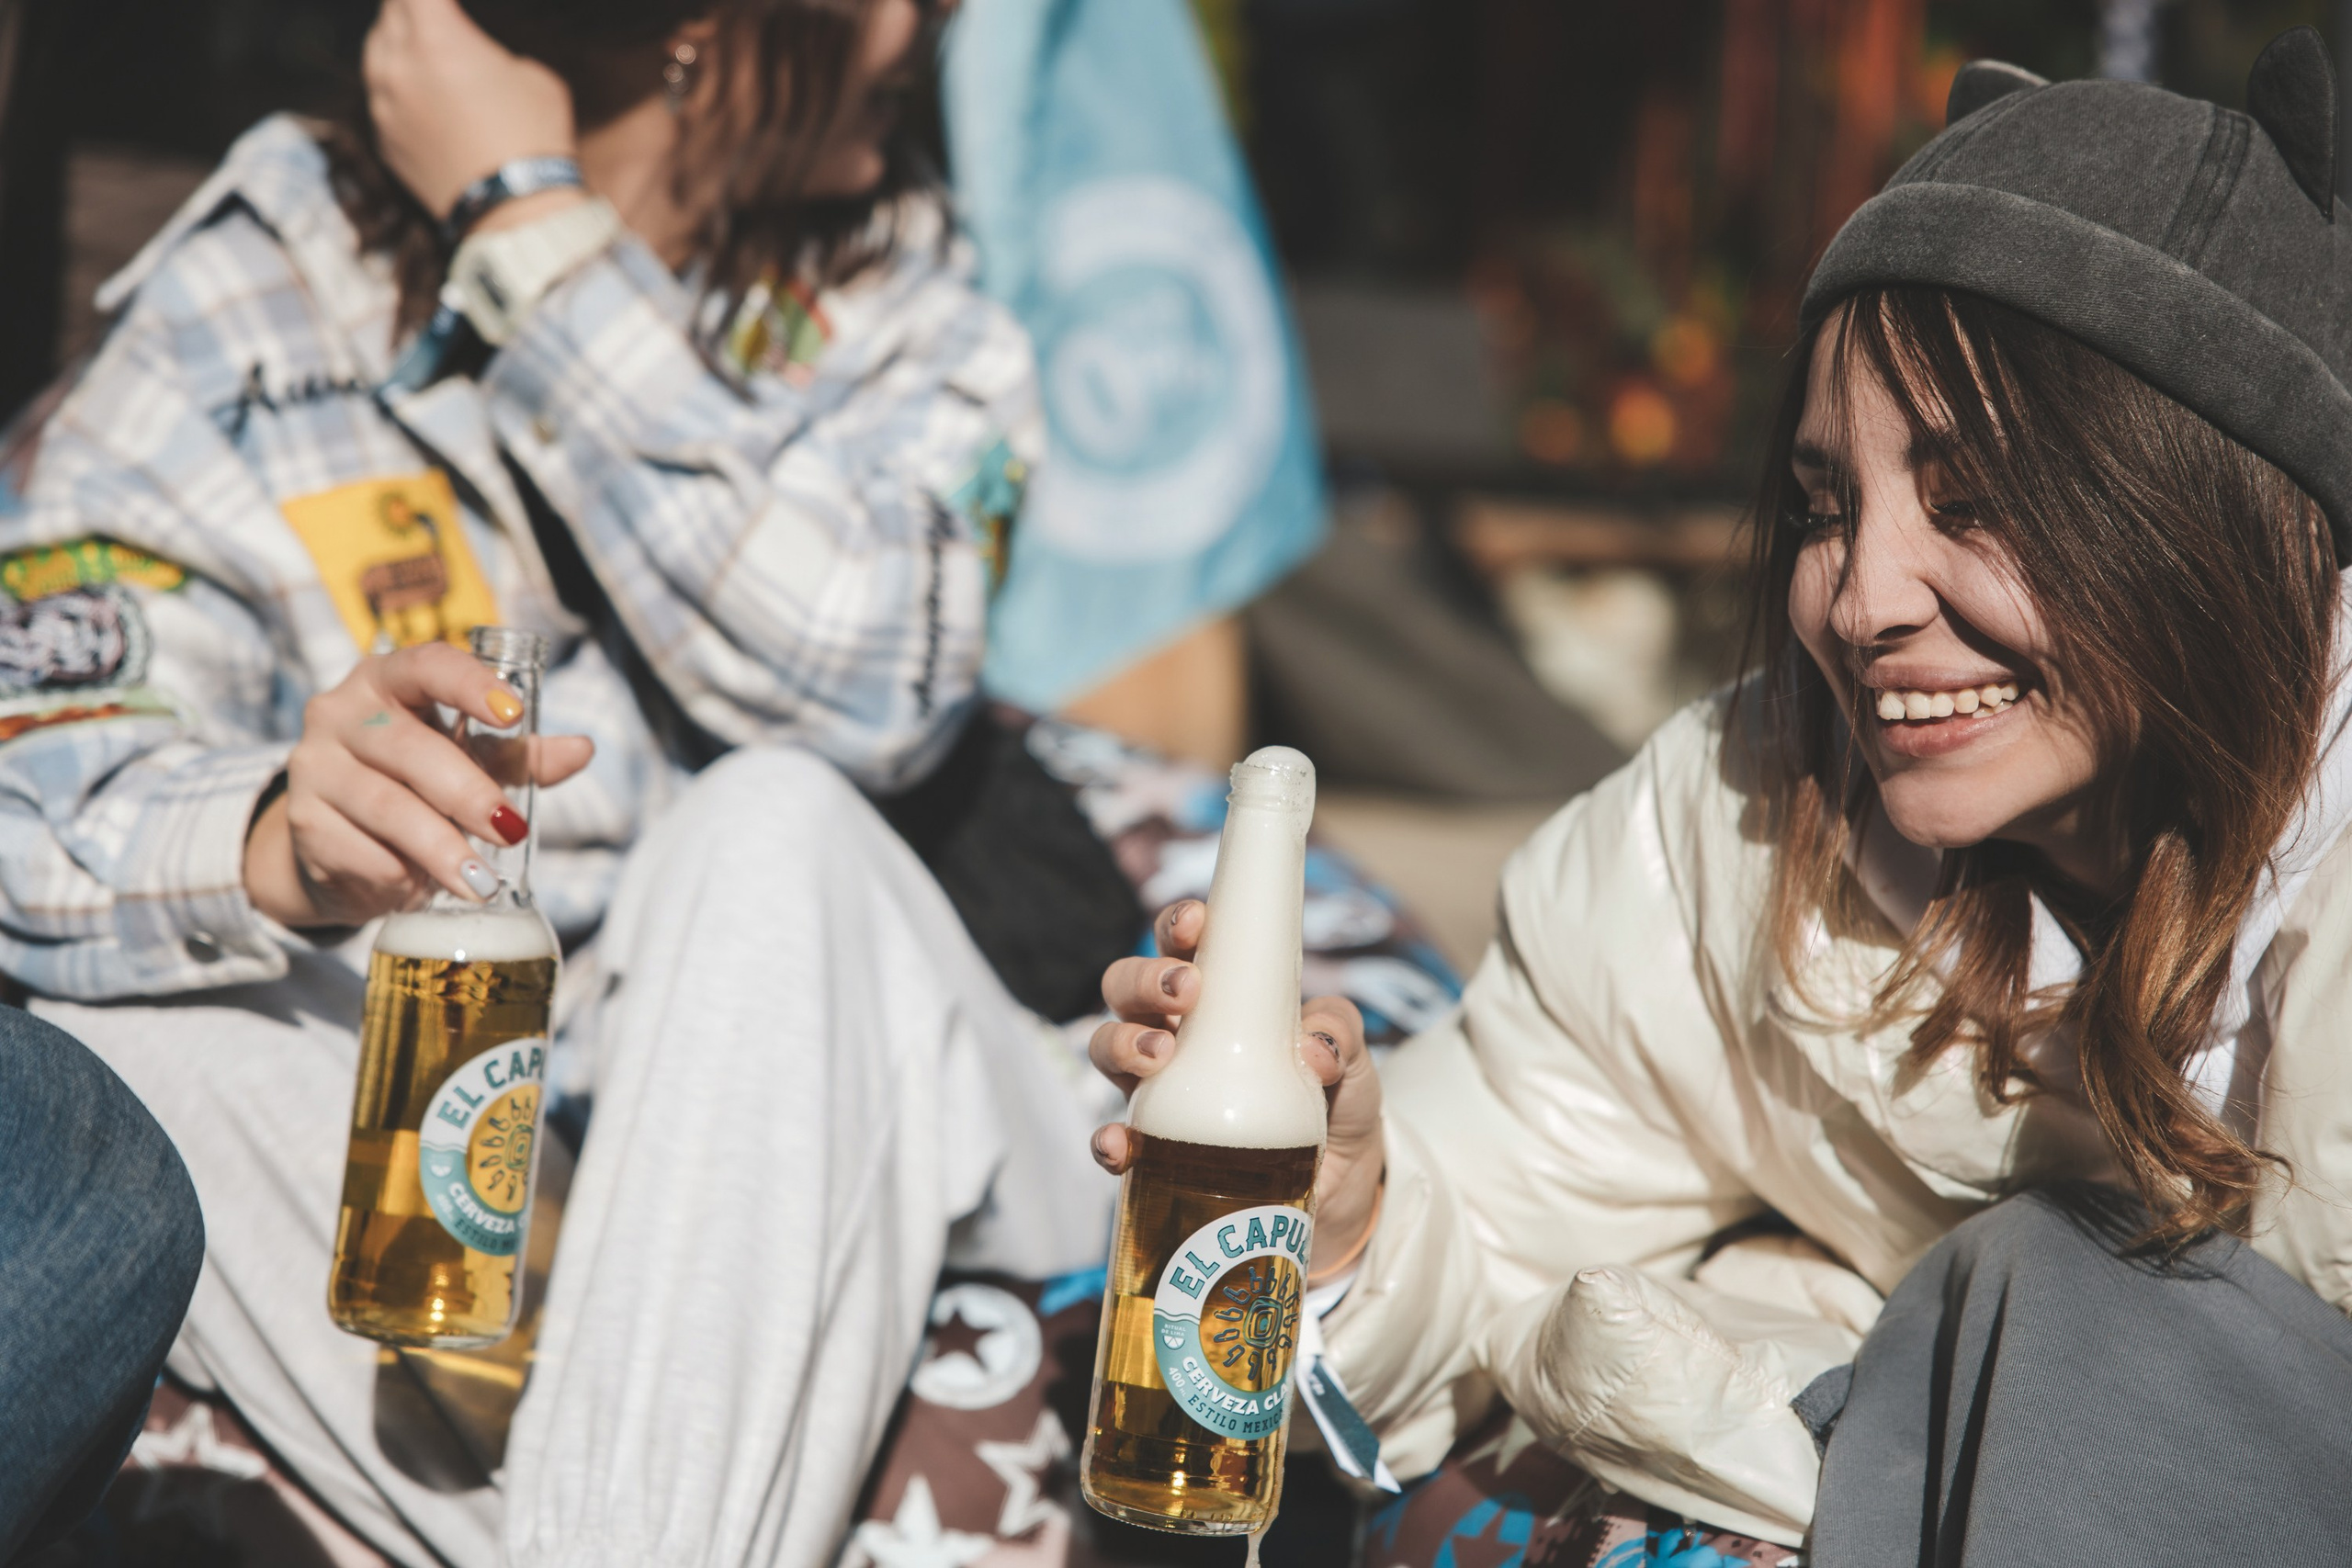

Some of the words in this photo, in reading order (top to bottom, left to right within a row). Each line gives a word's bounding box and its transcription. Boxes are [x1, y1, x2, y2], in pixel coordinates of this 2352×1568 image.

[436, 1086, 485, 1130] EL
[448, 1182, 514, 1234] CERVEZA
[1169, 1250, 1220, 1300] EL
[1164, 1324, 1186, 1332] RITUAL
[1169, 1367, 1186, 1388] 400
[1182, 1356, 1260, 1416] CERVEZA
[1188, 1393, 1237, 1431] ESTILO
